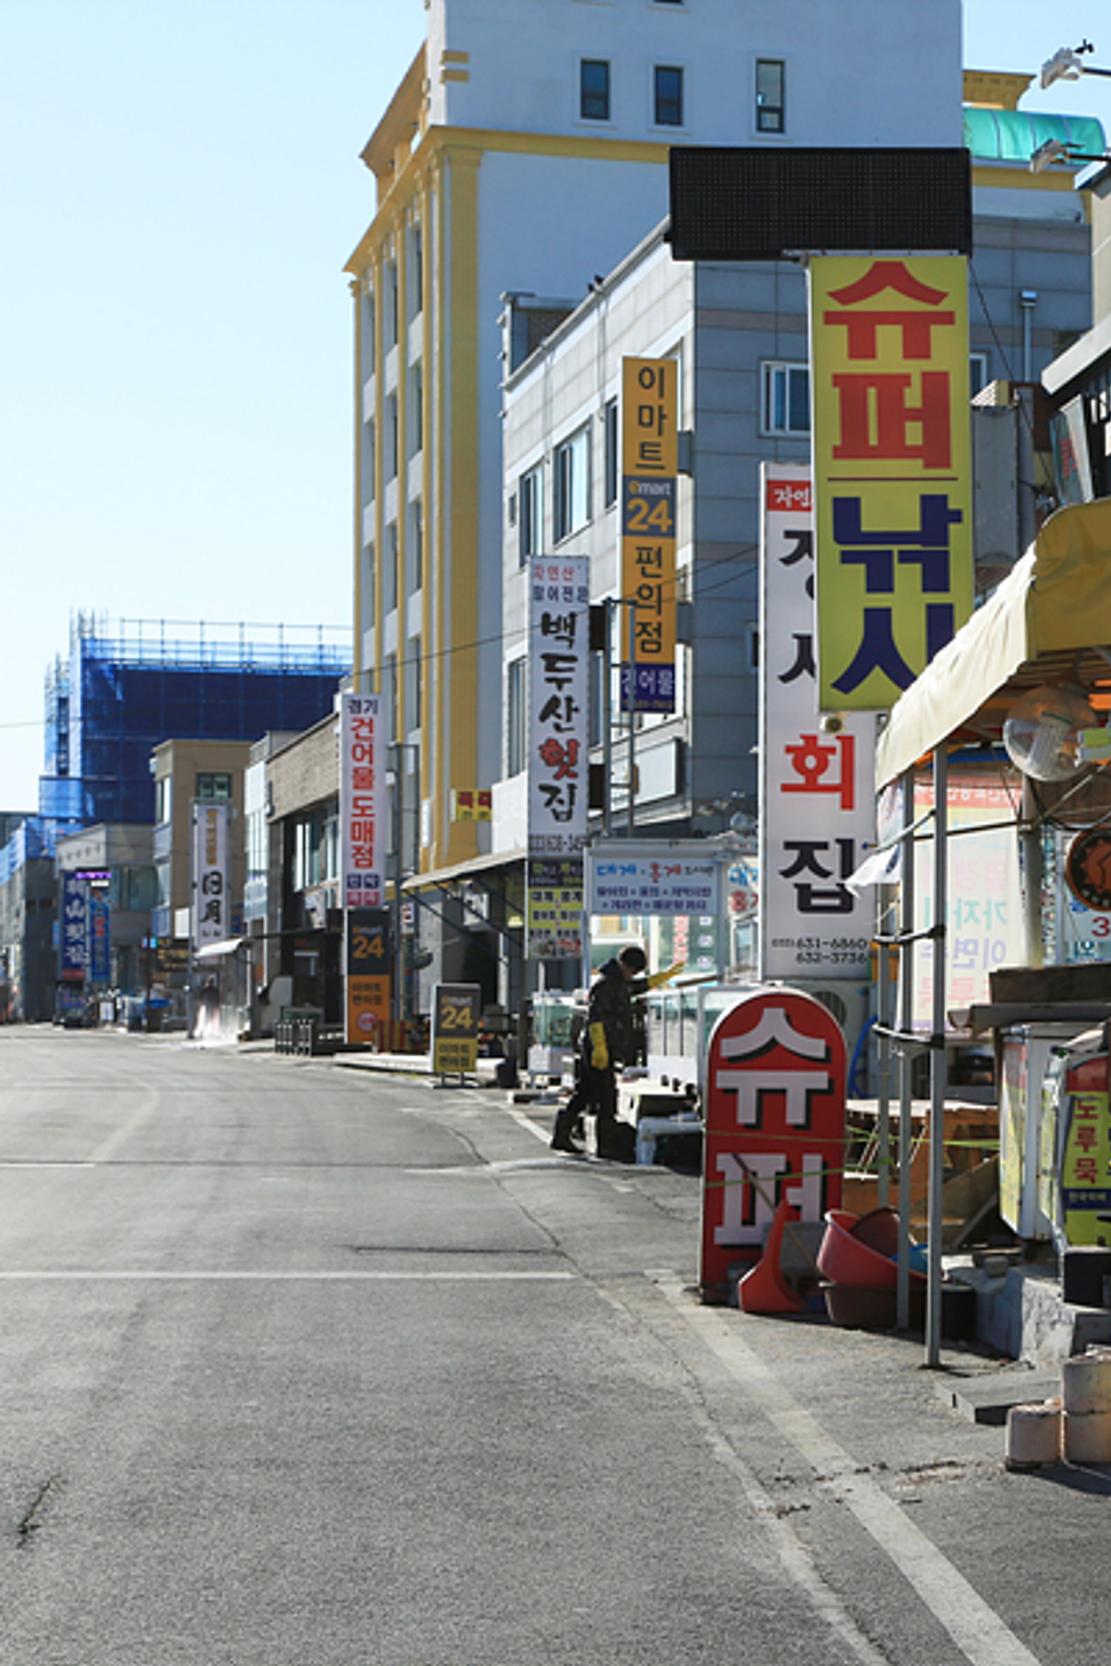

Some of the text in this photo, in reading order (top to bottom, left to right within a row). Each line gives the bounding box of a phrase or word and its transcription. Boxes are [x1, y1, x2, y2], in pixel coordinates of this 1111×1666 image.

[824, 261, 955, 469] 슈퍼
[636, 366, 667, 470] 이마트
[626, 499, 672, 533] 24
[628, 481, 671, 496] emart
[772, 485, 809, 511] 자연
[635, 546, 663, 654] 편의점
[831, 494, 963, 697] 낚시
[538, 611, 580, 823] 백두산횟집
[351, 936, 384, 959] 24
[1091, 916, 1111, 938] 3
[441, 1007, 473, 1029] 24
[714, 1007, 830, 1245] 슈퍼
